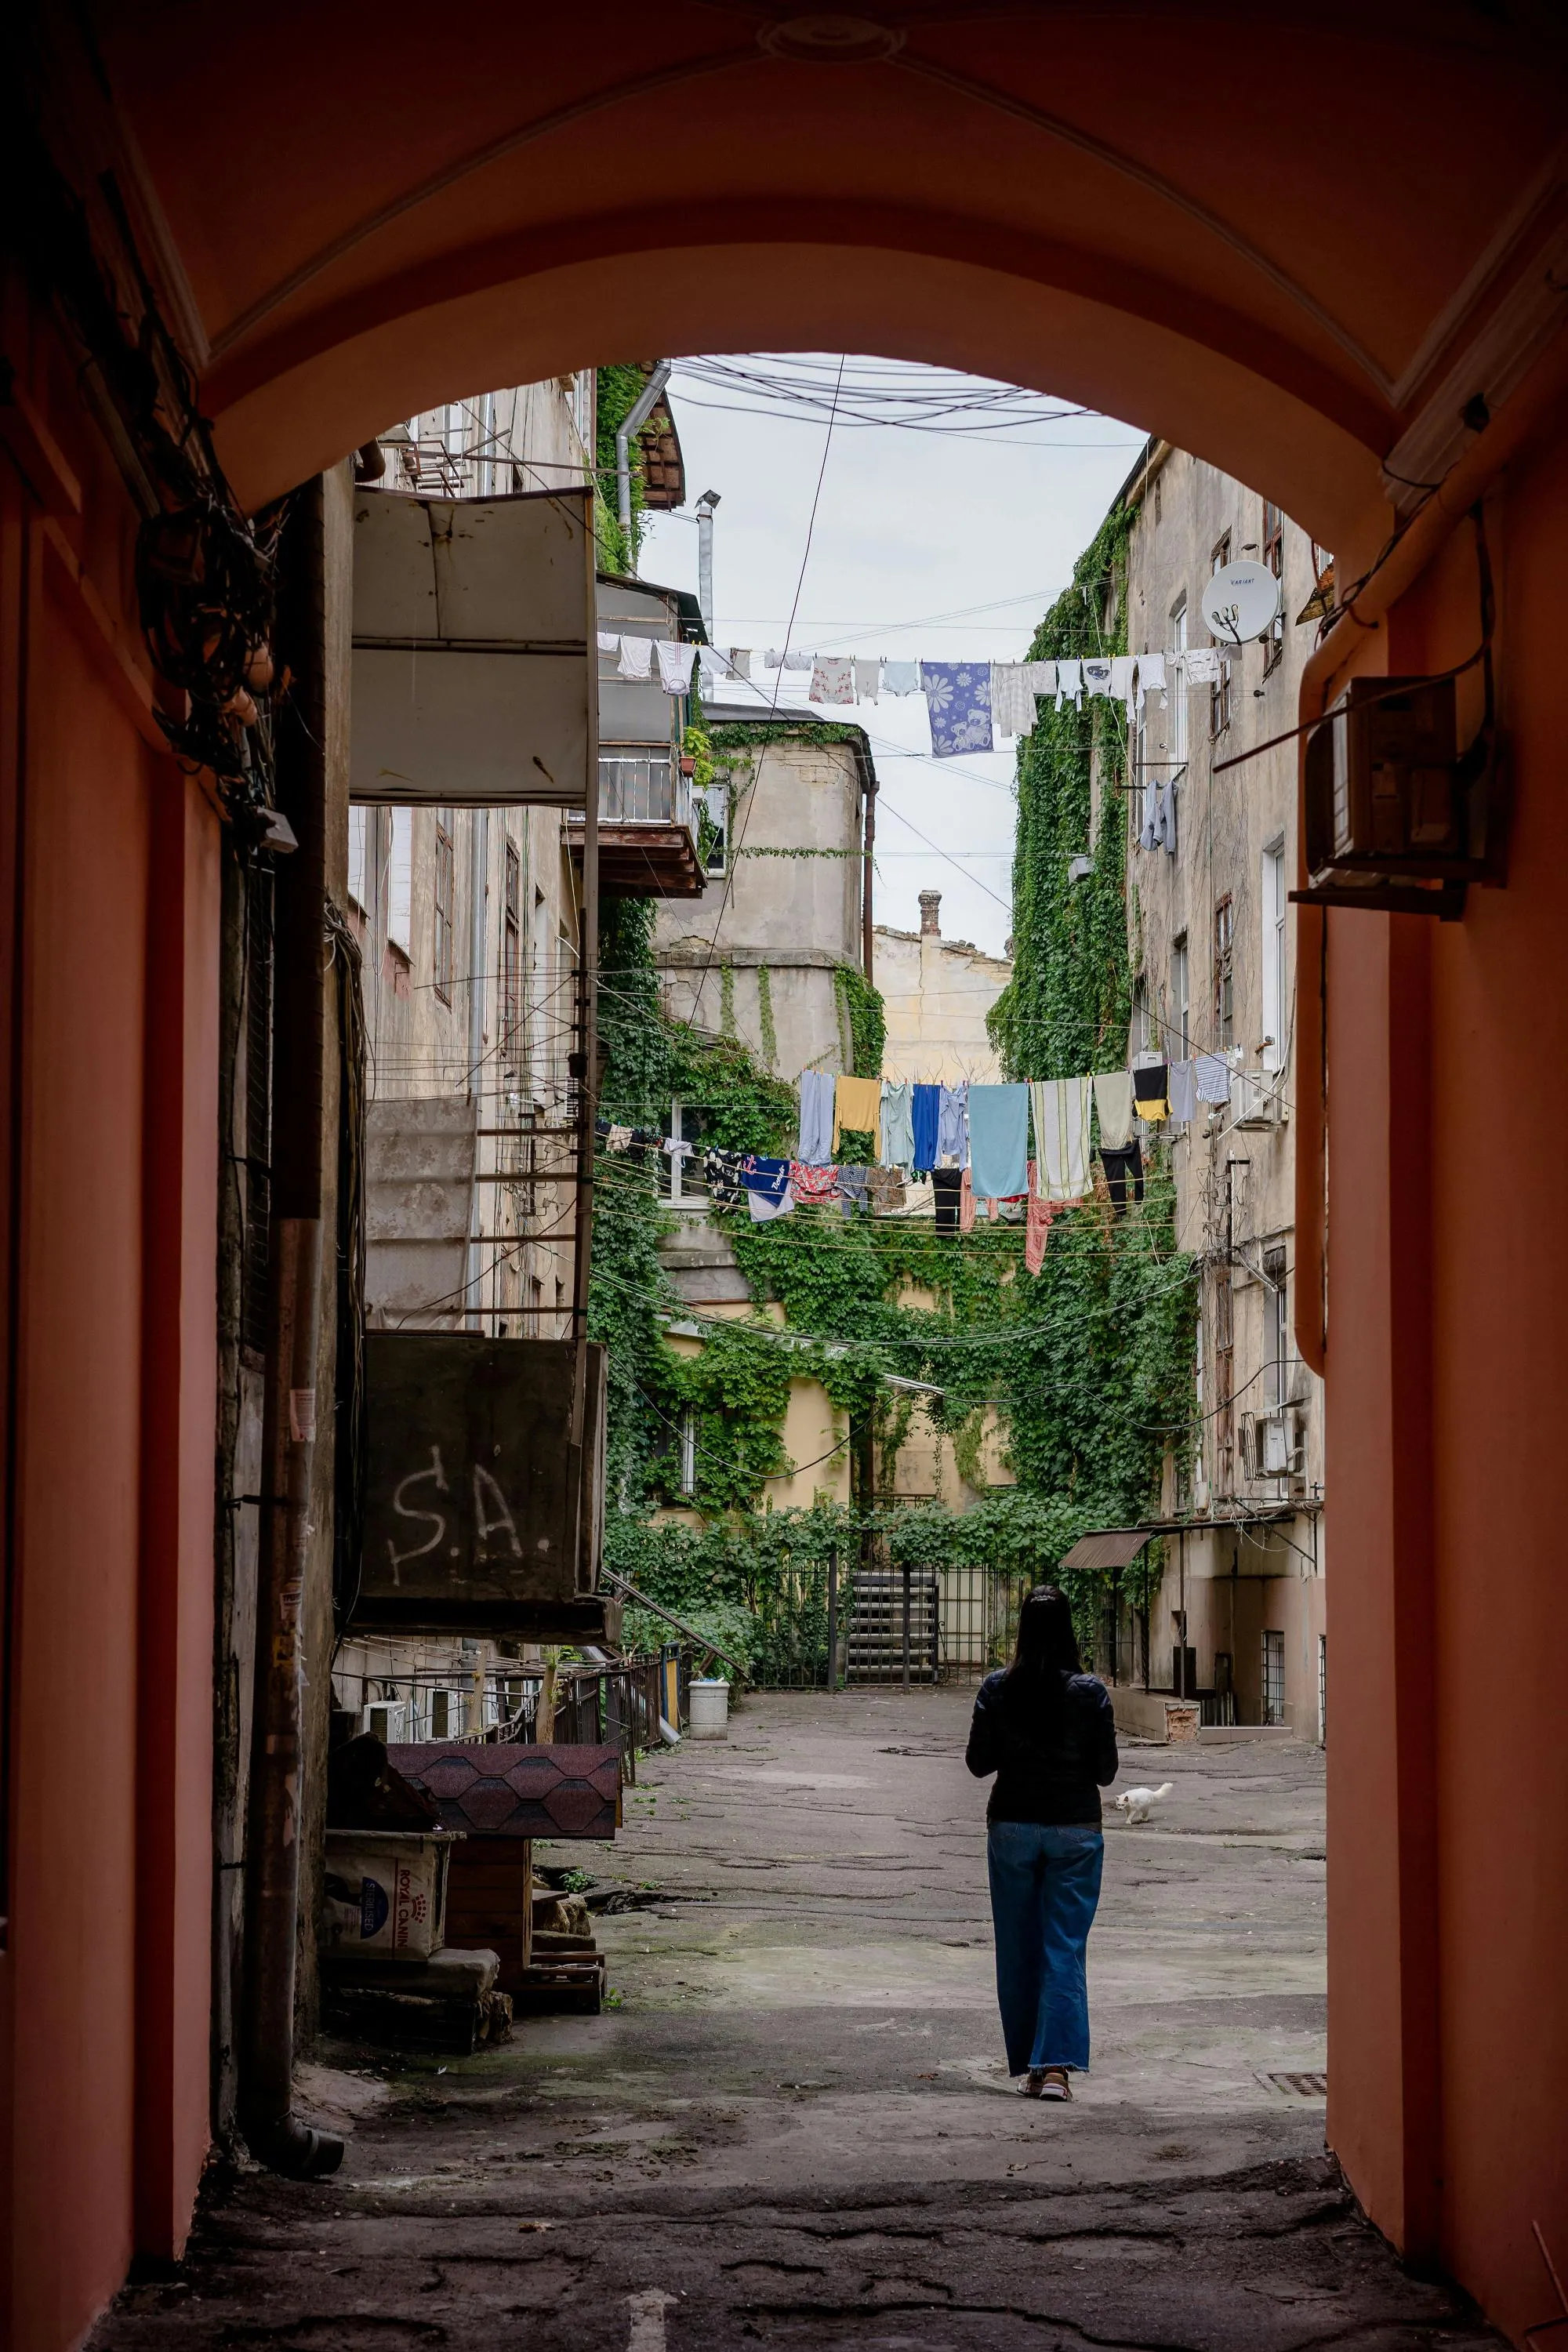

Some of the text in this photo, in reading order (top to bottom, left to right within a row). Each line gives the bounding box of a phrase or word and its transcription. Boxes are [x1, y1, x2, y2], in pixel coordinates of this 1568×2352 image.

[365, 1882, 376, 1931] STERILISED
[398, 1870, 410, 1947] ROYAL CANIN
